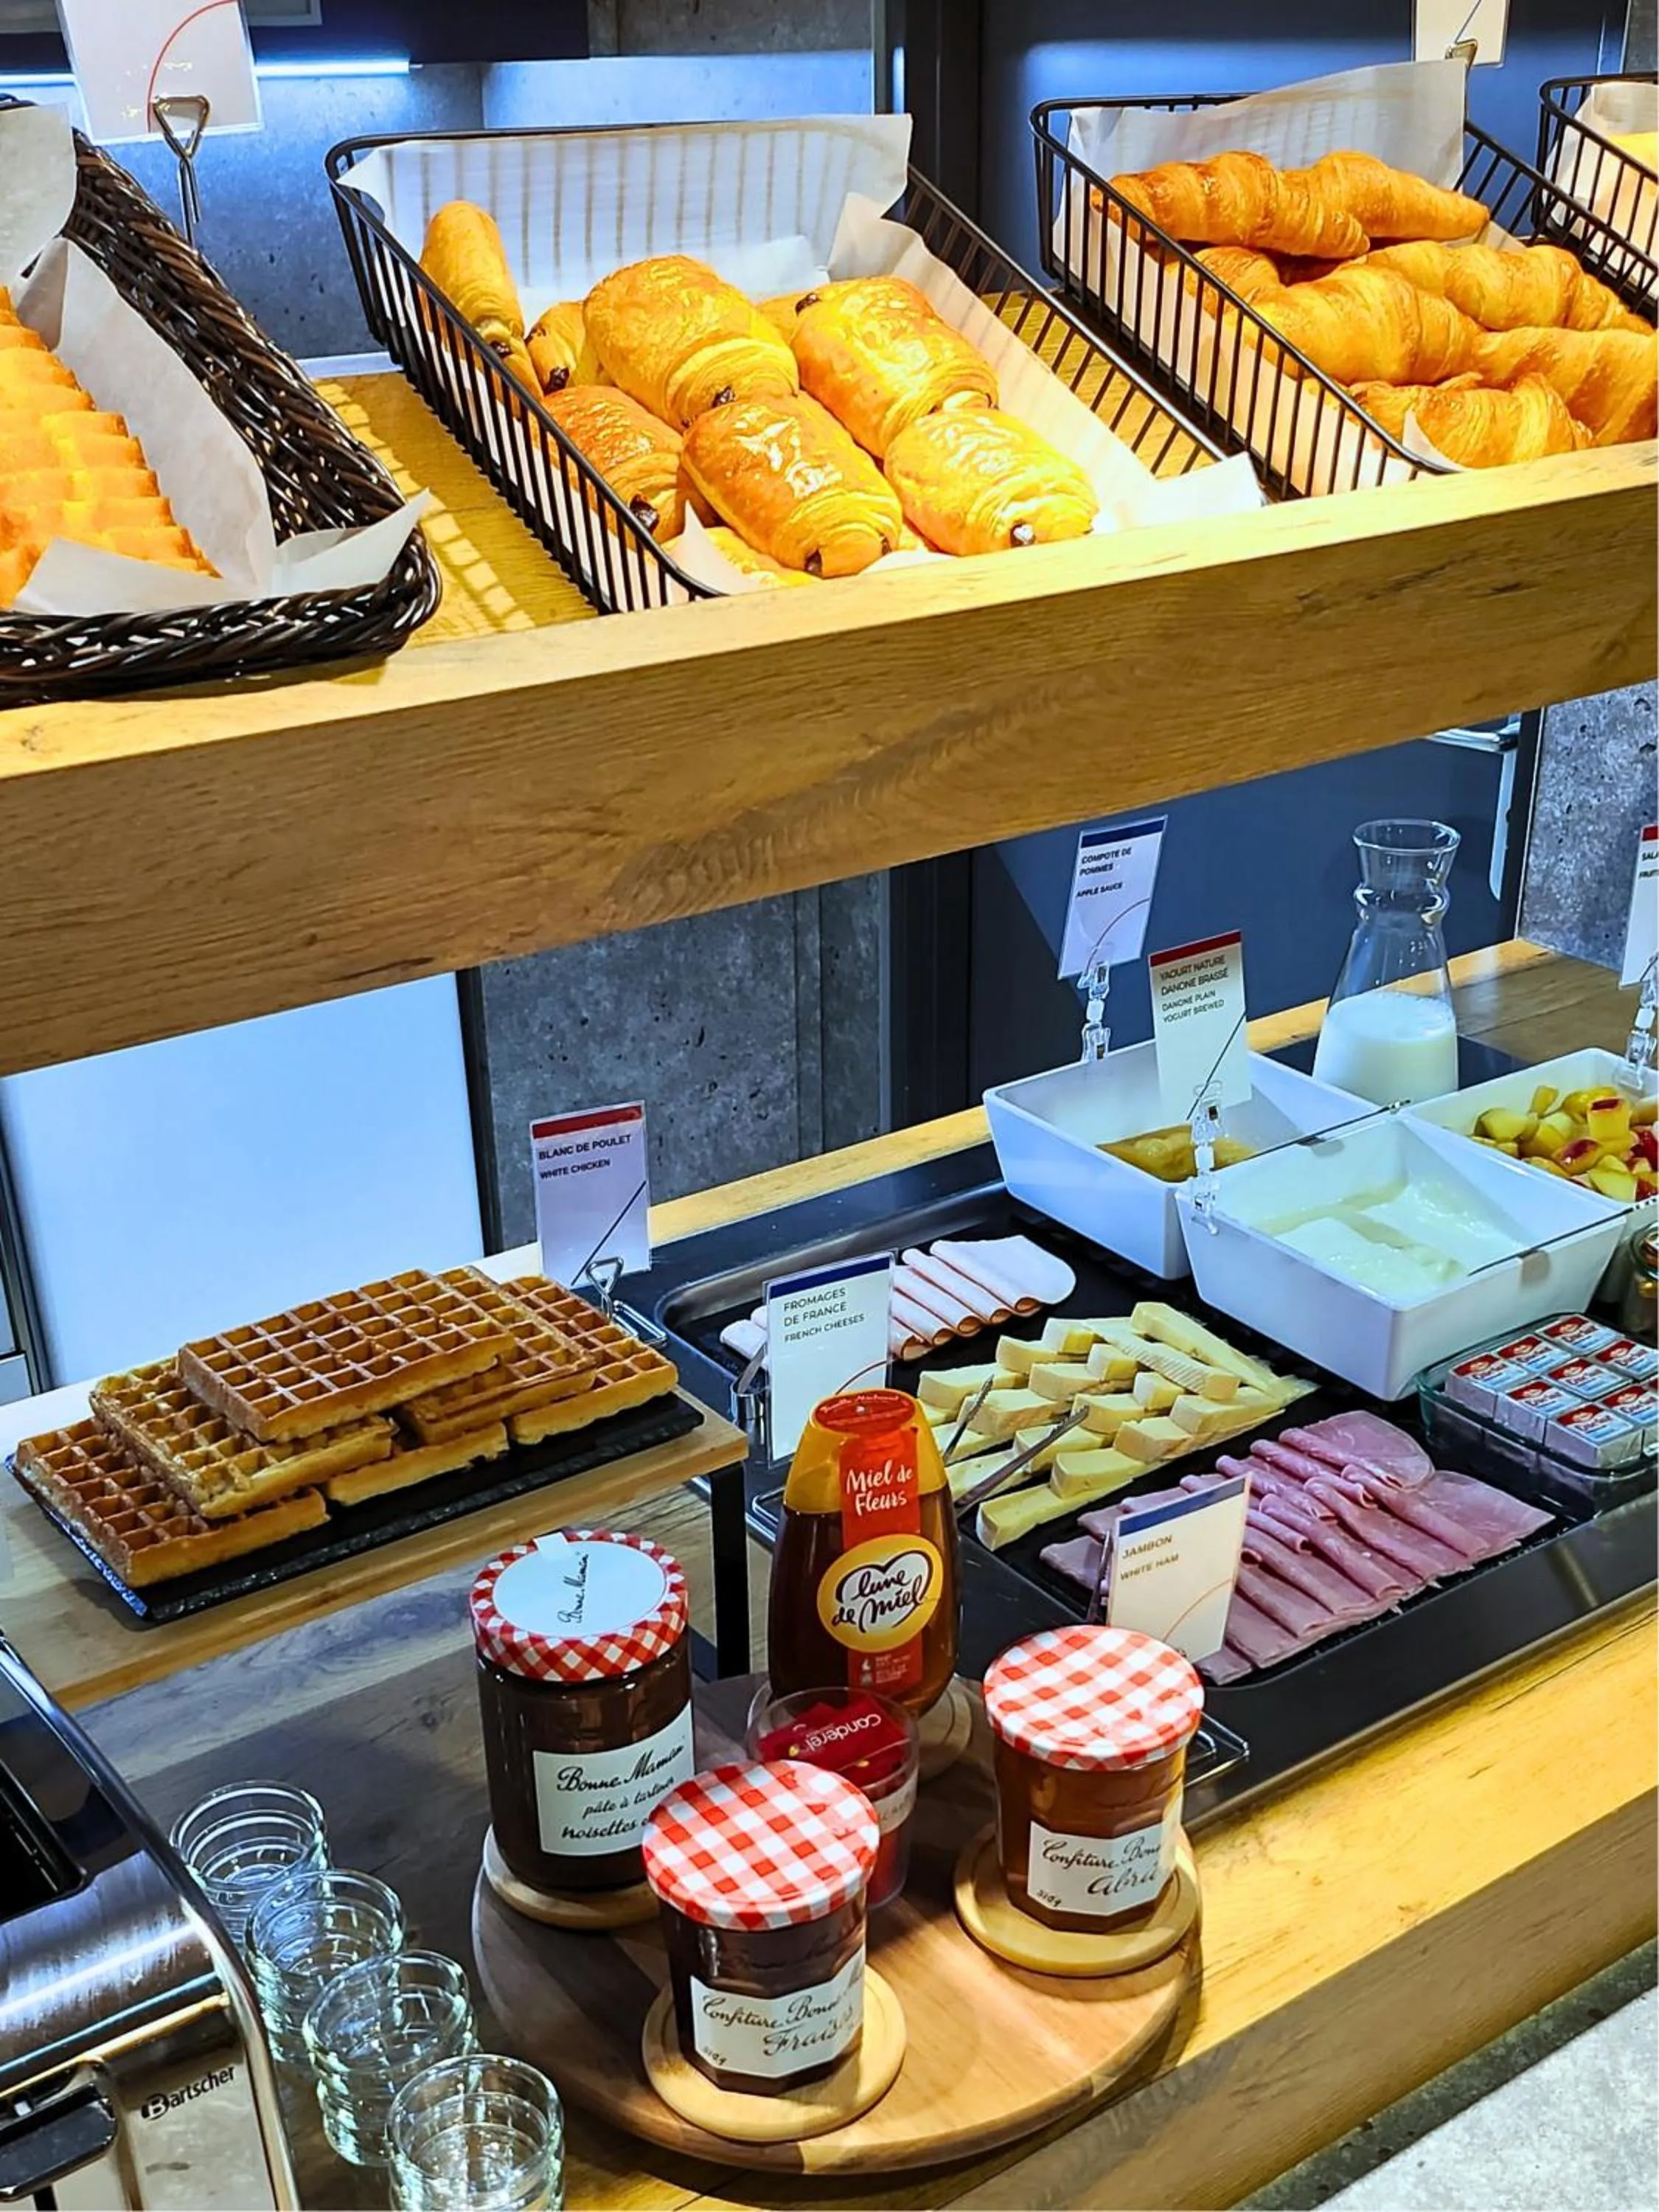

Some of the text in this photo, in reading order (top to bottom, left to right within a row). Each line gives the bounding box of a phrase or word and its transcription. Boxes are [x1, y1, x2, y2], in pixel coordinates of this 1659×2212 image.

[1082, 846, 1132, 864] COMPOTE DE
[1079, 863, 1113, 876] POMMES
[1077, 882, 1122, 897] APPLE SAUCE
[1160, 954, 1225, 981] YAOURT NATURE
[1161, 978, 1196, 995] DANONE
[1162, 990, 1216, 1012] DANONE PLAIN
[1163, 1007, 1192, 1023] YOGURT
[539, 1133, 631, 1160] BLANC DE POULET
[540, 1158, 611, 1180] WHITE CHICKEN
[784, 1287, 846, 1312] FROMAGES
[784, 1301, 846, 1326] DE FRANCE
[784, 1313, 865, 1343] FRENCH CHEESES
[846, 1458, 913, 1495] Miel de
[855, 1489, 907, 1517] Fleurs
[1122, 1534, 1172, 1559] JAMBON
[1121, 1553, 1179, 1580] WHITE HAM
[832, 1606, 856, 1627] de
[557, 1745, 684, 1792] Bonne Maman
[582, 1800, 616, 1820] pâte
[619, 1795, 629, 1809] à
[562, 1818, 636, 1839] noisettes
[1042, 1839, 1119, 1871] Confiture
[703, 1994, 780, 2028] Confiture
[142, 2067, 234, 2121] Bartscher
